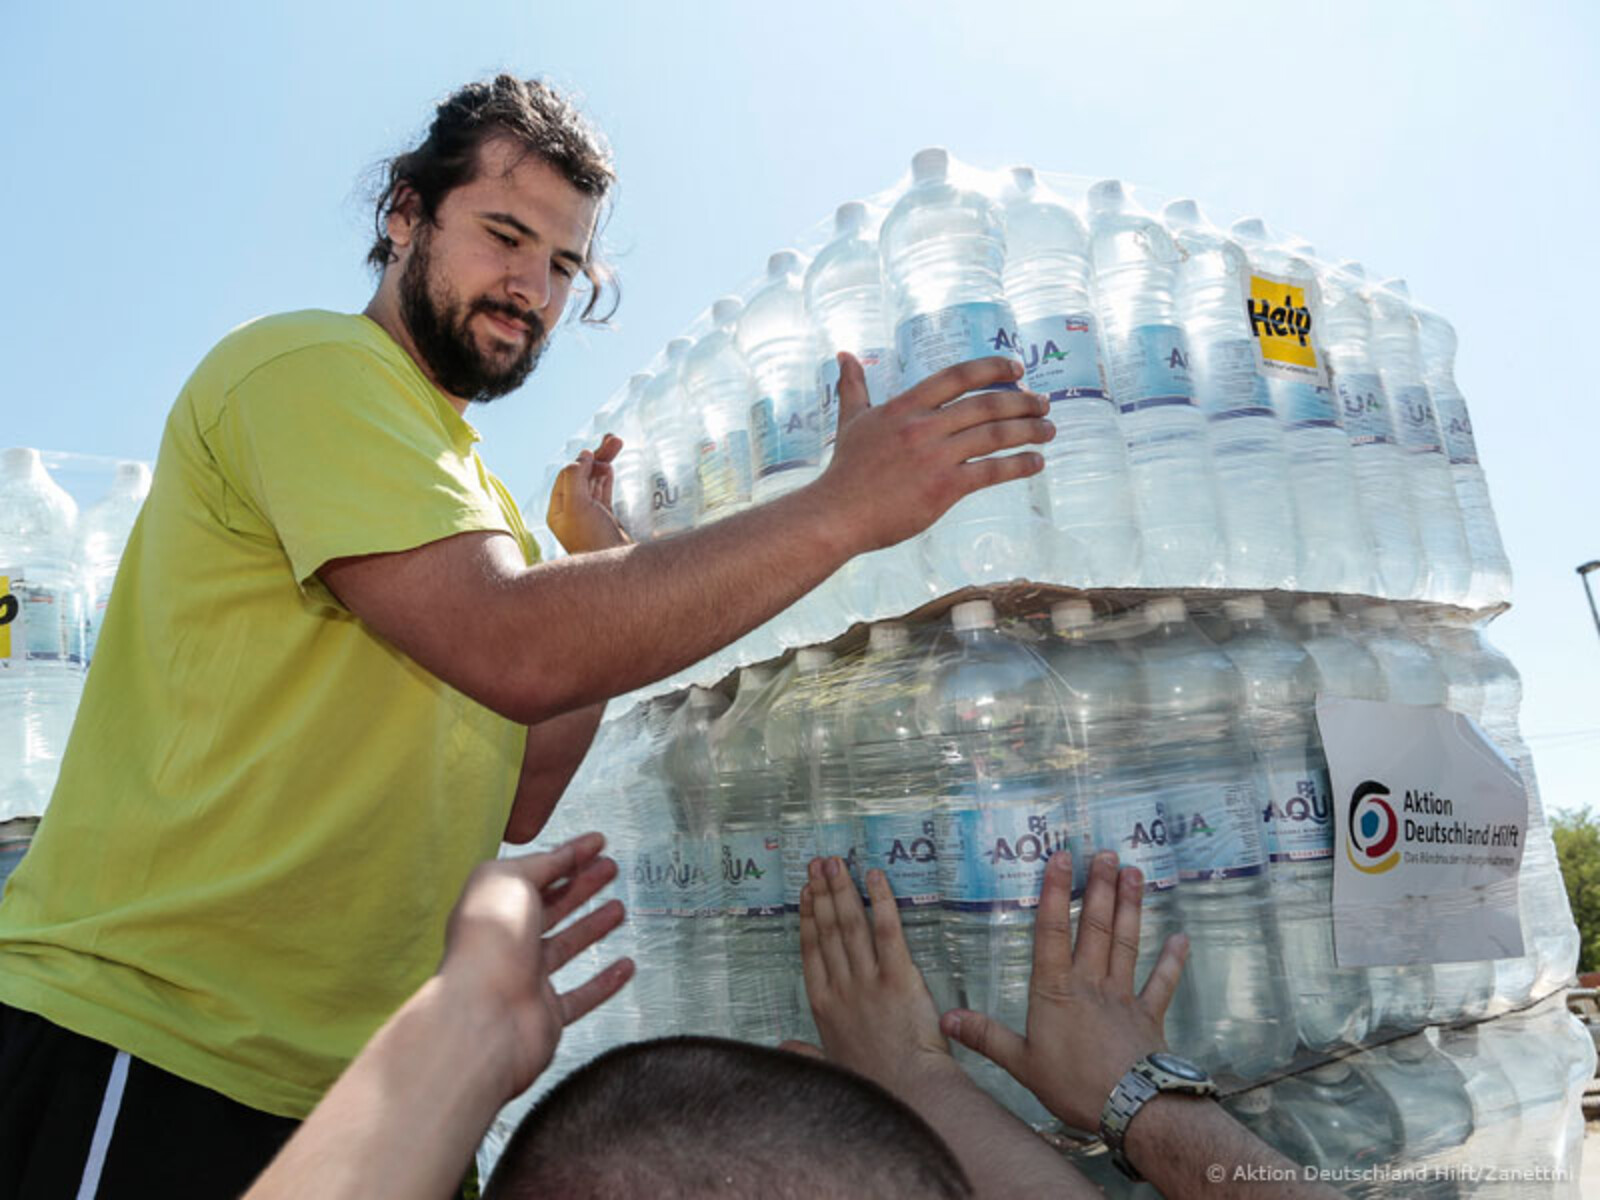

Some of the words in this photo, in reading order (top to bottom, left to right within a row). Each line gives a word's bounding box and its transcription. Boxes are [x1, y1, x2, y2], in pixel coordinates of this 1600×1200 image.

[1247, 294, 1312, 347] Help
[1262, 795, 1328, 825] AQU
[1403, 789, 1453, 817] Aktion
[1404, 818, 1491, 846] Deutschland
[1491, 823, 1519, 848] Hilft
